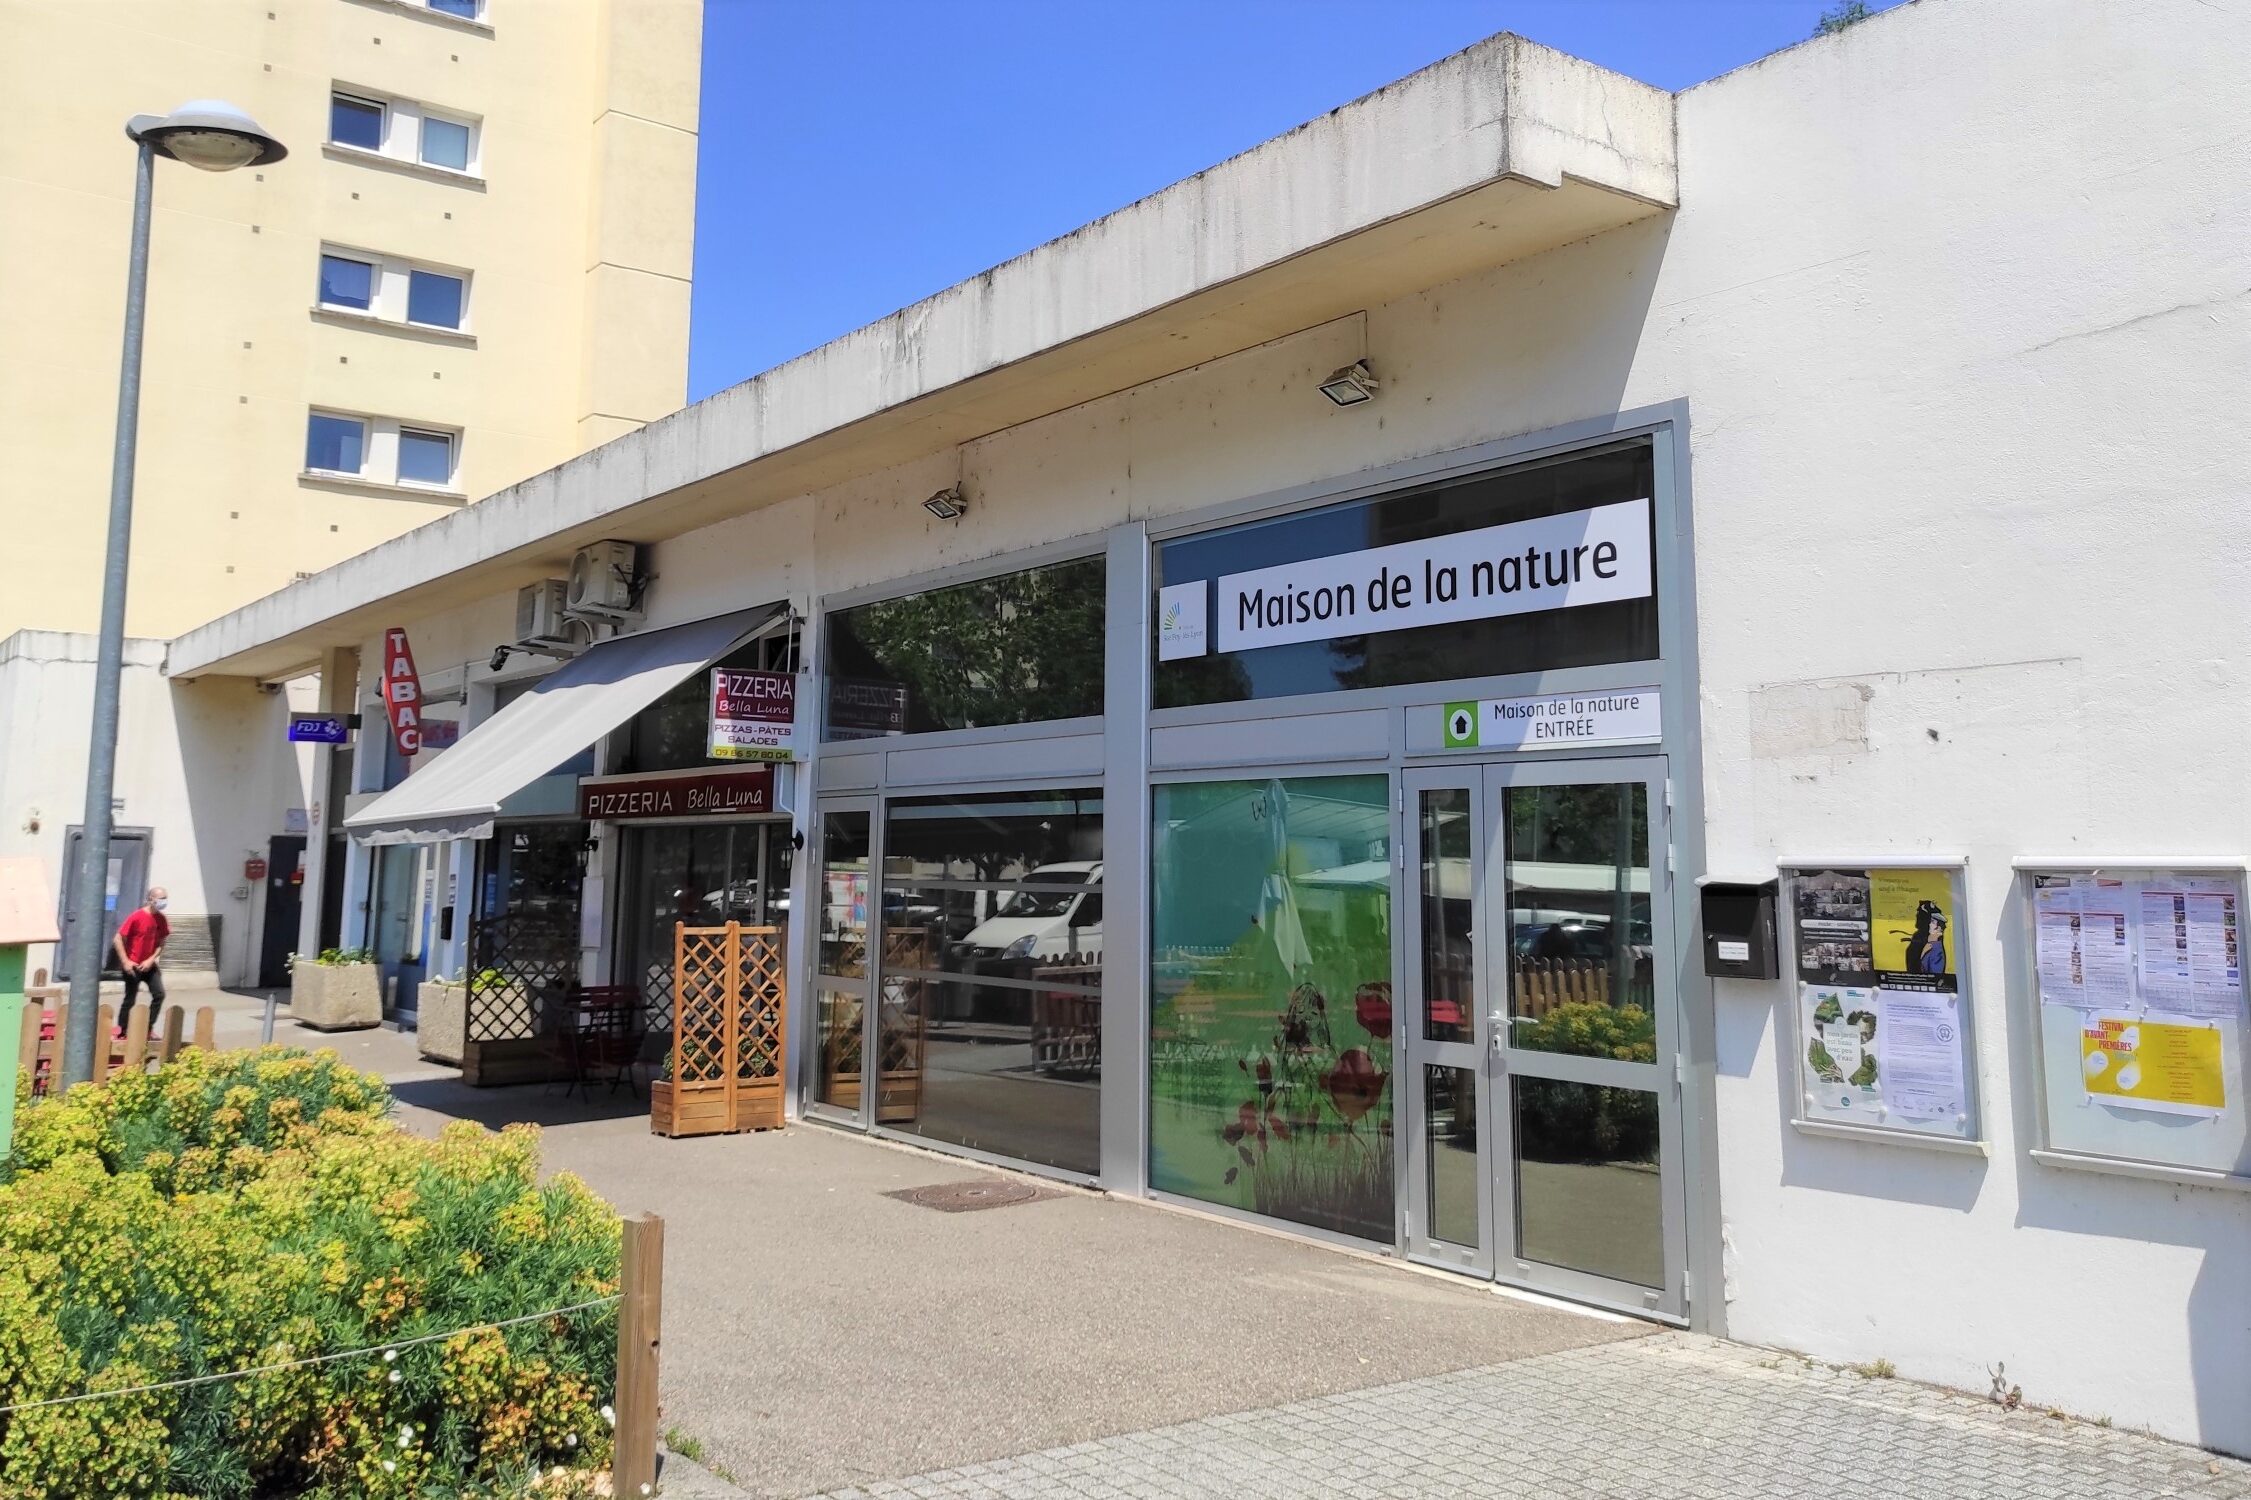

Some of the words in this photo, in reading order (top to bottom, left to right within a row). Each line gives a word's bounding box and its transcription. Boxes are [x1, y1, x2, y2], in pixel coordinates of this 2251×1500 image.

[1239, 584, 1355, 632] Maison
[1367, 567, 1412, 613] de
[1425, 559, 1458, 605] la
[1472, 541, 1617, 598] nature
[390, 633, 417, 749] TABAC
[716, 673, 793, 700] PIZZERIA
[719, 700, 751, 712] Bella
[757, 703, 789, 714] Luna
[1494, 703, 1544, 720] Maison
[1549, 699, 1566, 716] de
[1571, 697, 1584, 714] la
[1588, 696, 1639, 713] nature
[297, 722, 321, 732] FDJ
[1536, 715, 1594, 739] ENTRÉE
[728, 736, 778, 745] SALADES
[715, 748, 728, 756] 09
[746, 750, 758, 759] 57
[588, 790, 673, 815] PIZZERIA
[687, 786, 720, 809] Bella
[726, 787, 762, 806] Luna
[2098, 1021, 2124, 1032] FESTIVAL
